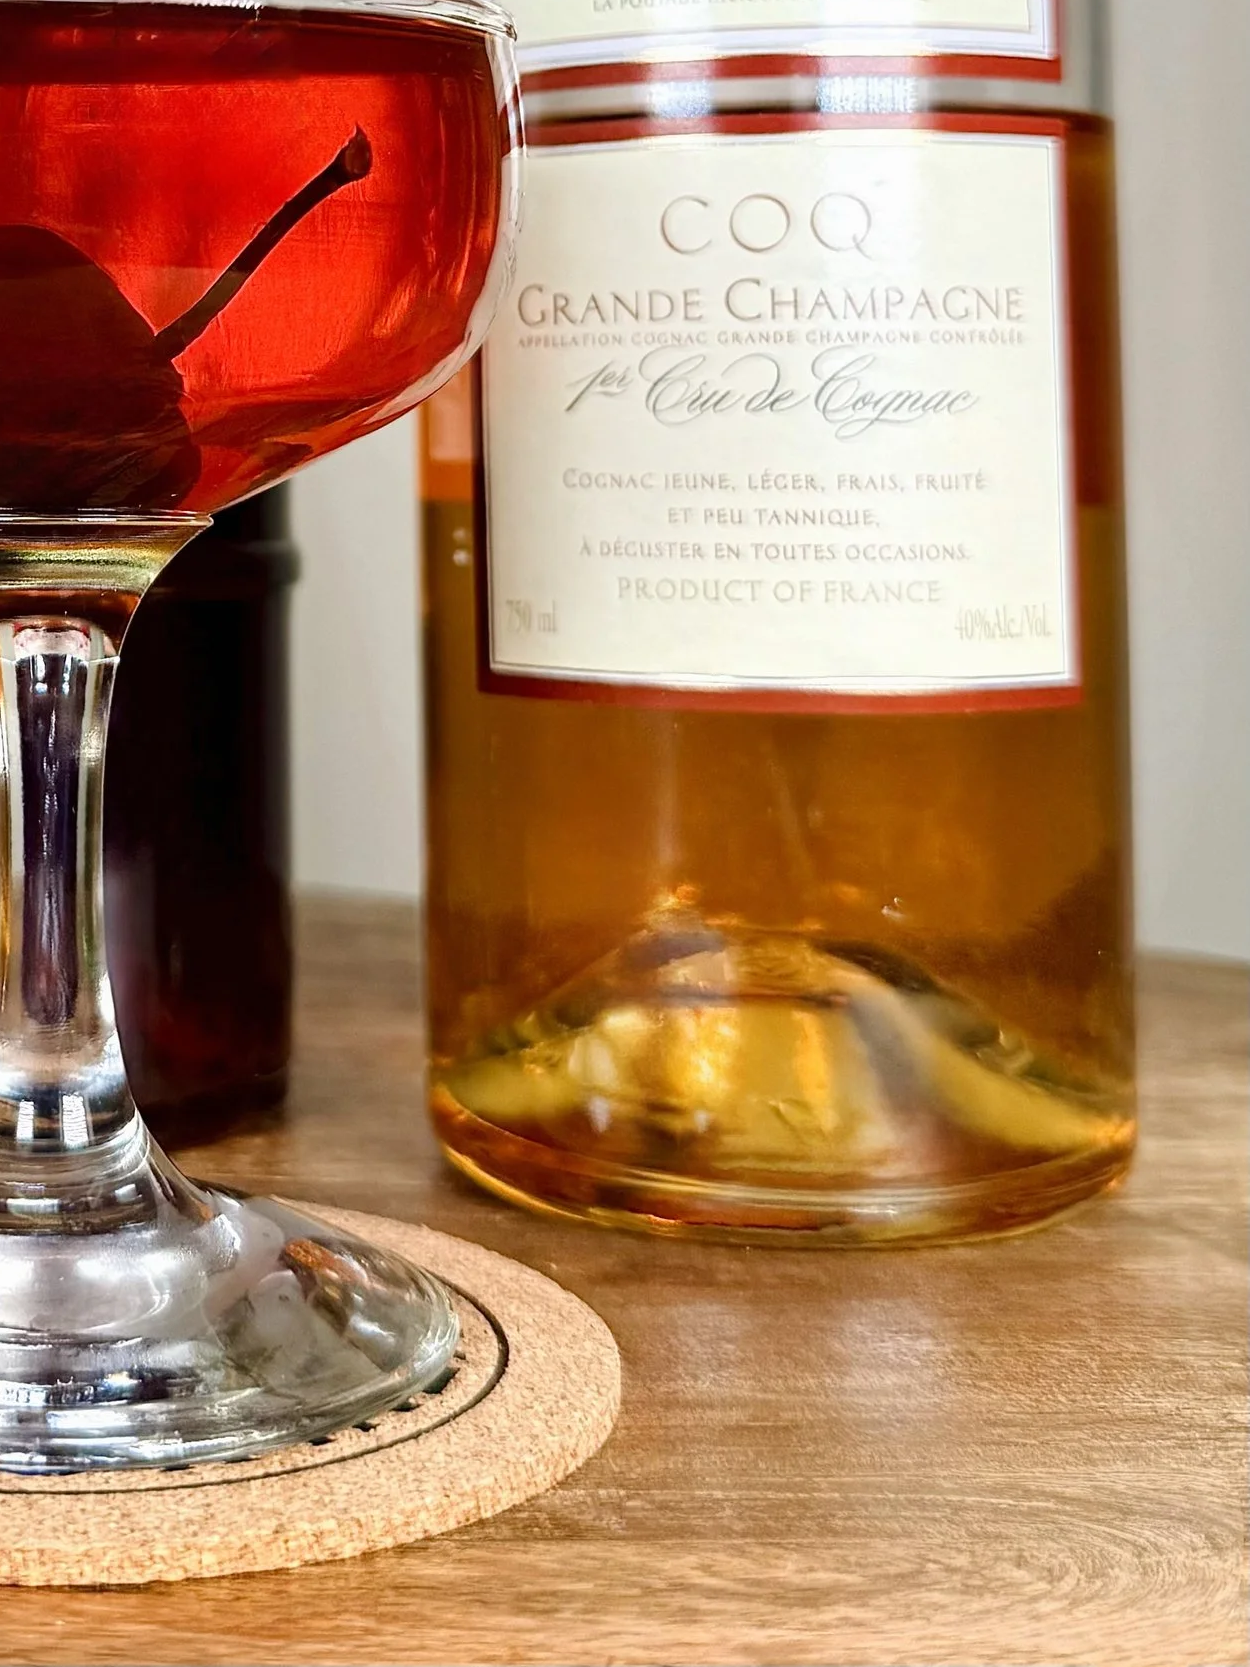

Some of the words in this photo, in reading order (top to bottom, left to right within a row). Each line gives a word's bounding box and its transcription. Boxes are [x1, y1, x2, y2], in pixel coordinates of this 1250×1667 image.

[660, 191, 873, 259] COQ
[517, 283, 704, 329] GRANDE
[724, 277, 1028, 325] CHAMPAGNE
[517, 332, 623, 349] APPELLATION
[630, 331, 708, 346] COGNAC
[716, 330, 796, 345] GRANDE
[805, 330, 921, 345] CHAMPAGNE
[637, 343, 746, 428] Cru
[720, 351, 812, 415] de
[810, 343, 982, 441] Cognac
[667, 507, 694, 526] ET
[703, 507, 744, 526] PEU
[579, 536, 592, 557] À
[599, 538, 705, 561] DÉGUSTER
[714, 541, 741, 560] EN
[750, 541, 837, 562] TOUTES
[617, 576, 764, 603] PRODUCT
[773, 579, 816, 603] OF
[824, 578, 944, 604] FRANCE
